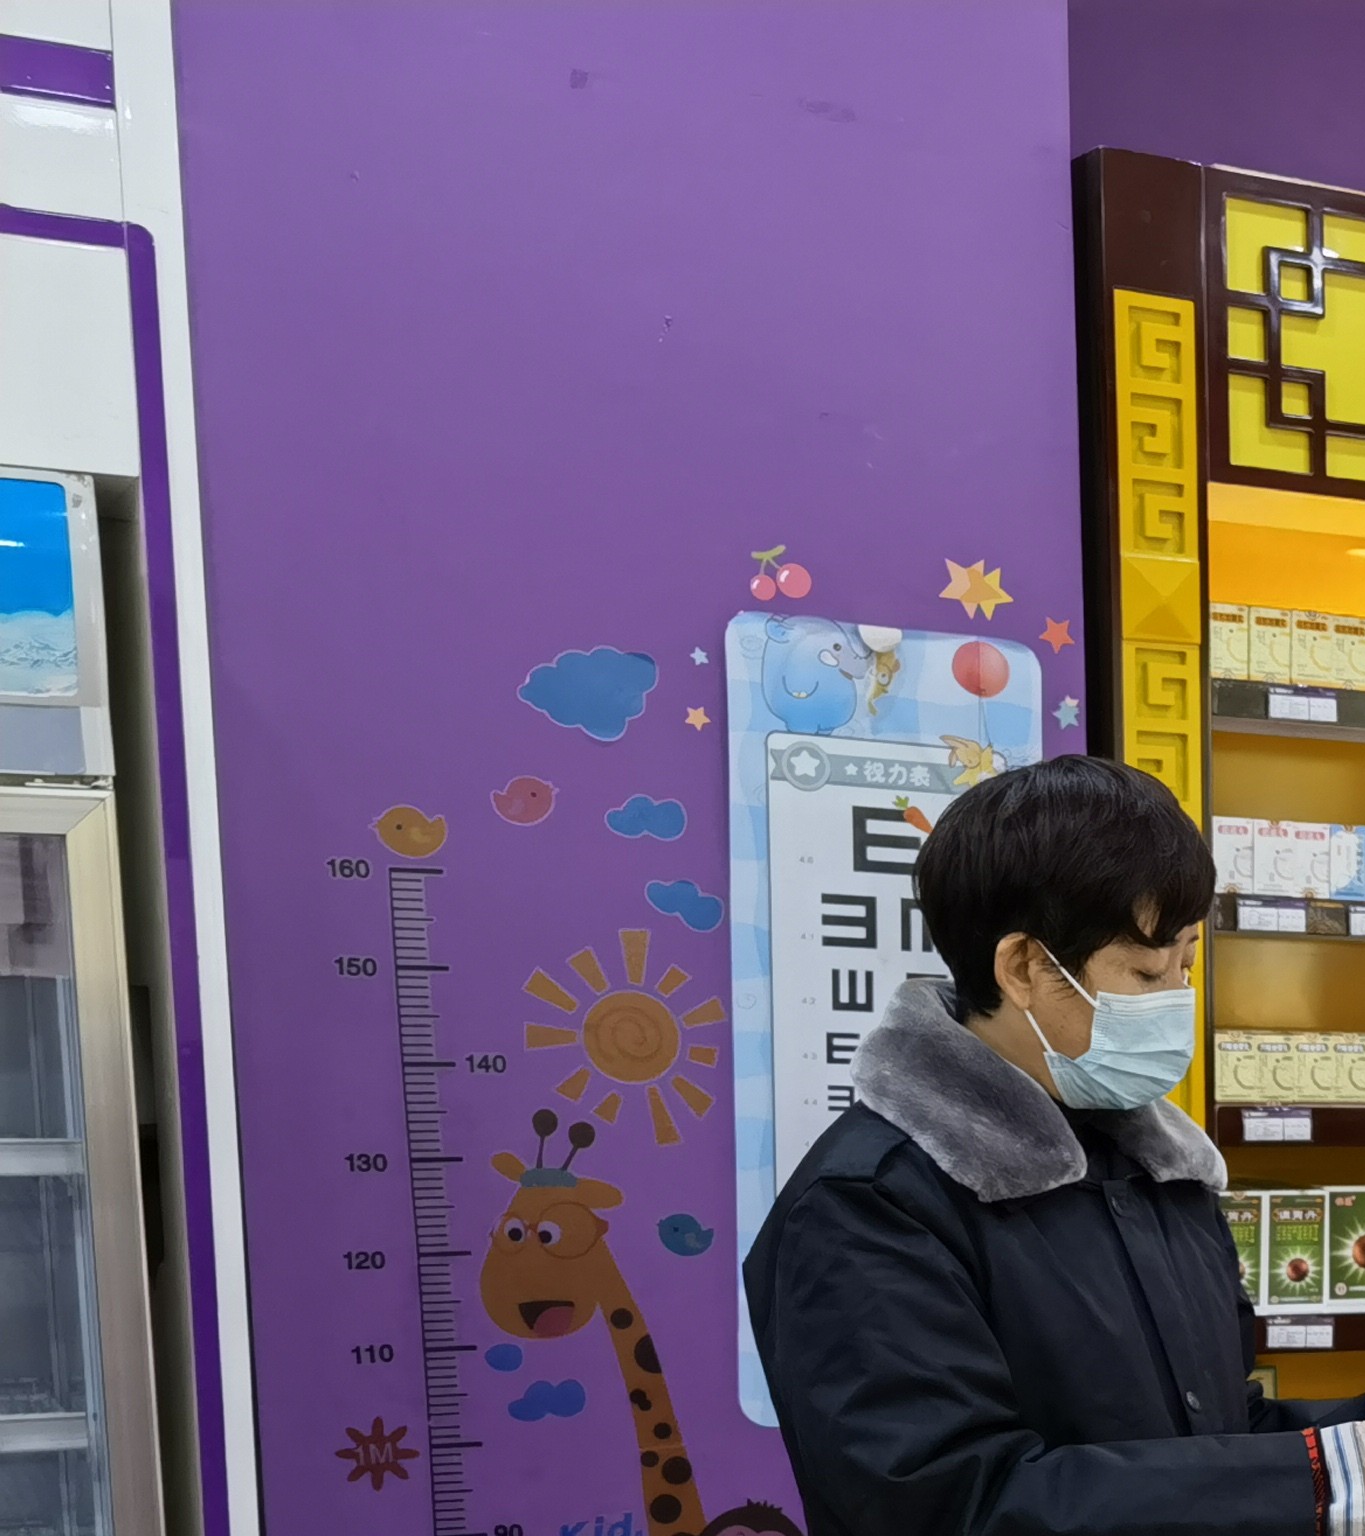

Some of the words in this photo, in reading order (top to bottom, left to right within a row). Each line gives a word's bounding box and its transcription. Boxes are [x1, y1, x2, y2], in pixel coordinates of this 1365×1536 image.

[326, 858, 370, 880] 160
[333, 957, 378, 978] 150
[465, 1053, 507, 1075] 140
[344, 1153, 388, 1174] 130
[343, 1250, 386, 1271] 120
[351, 1344, 394, 1365] 110
[354, 1444, 393, 1465] 1M
